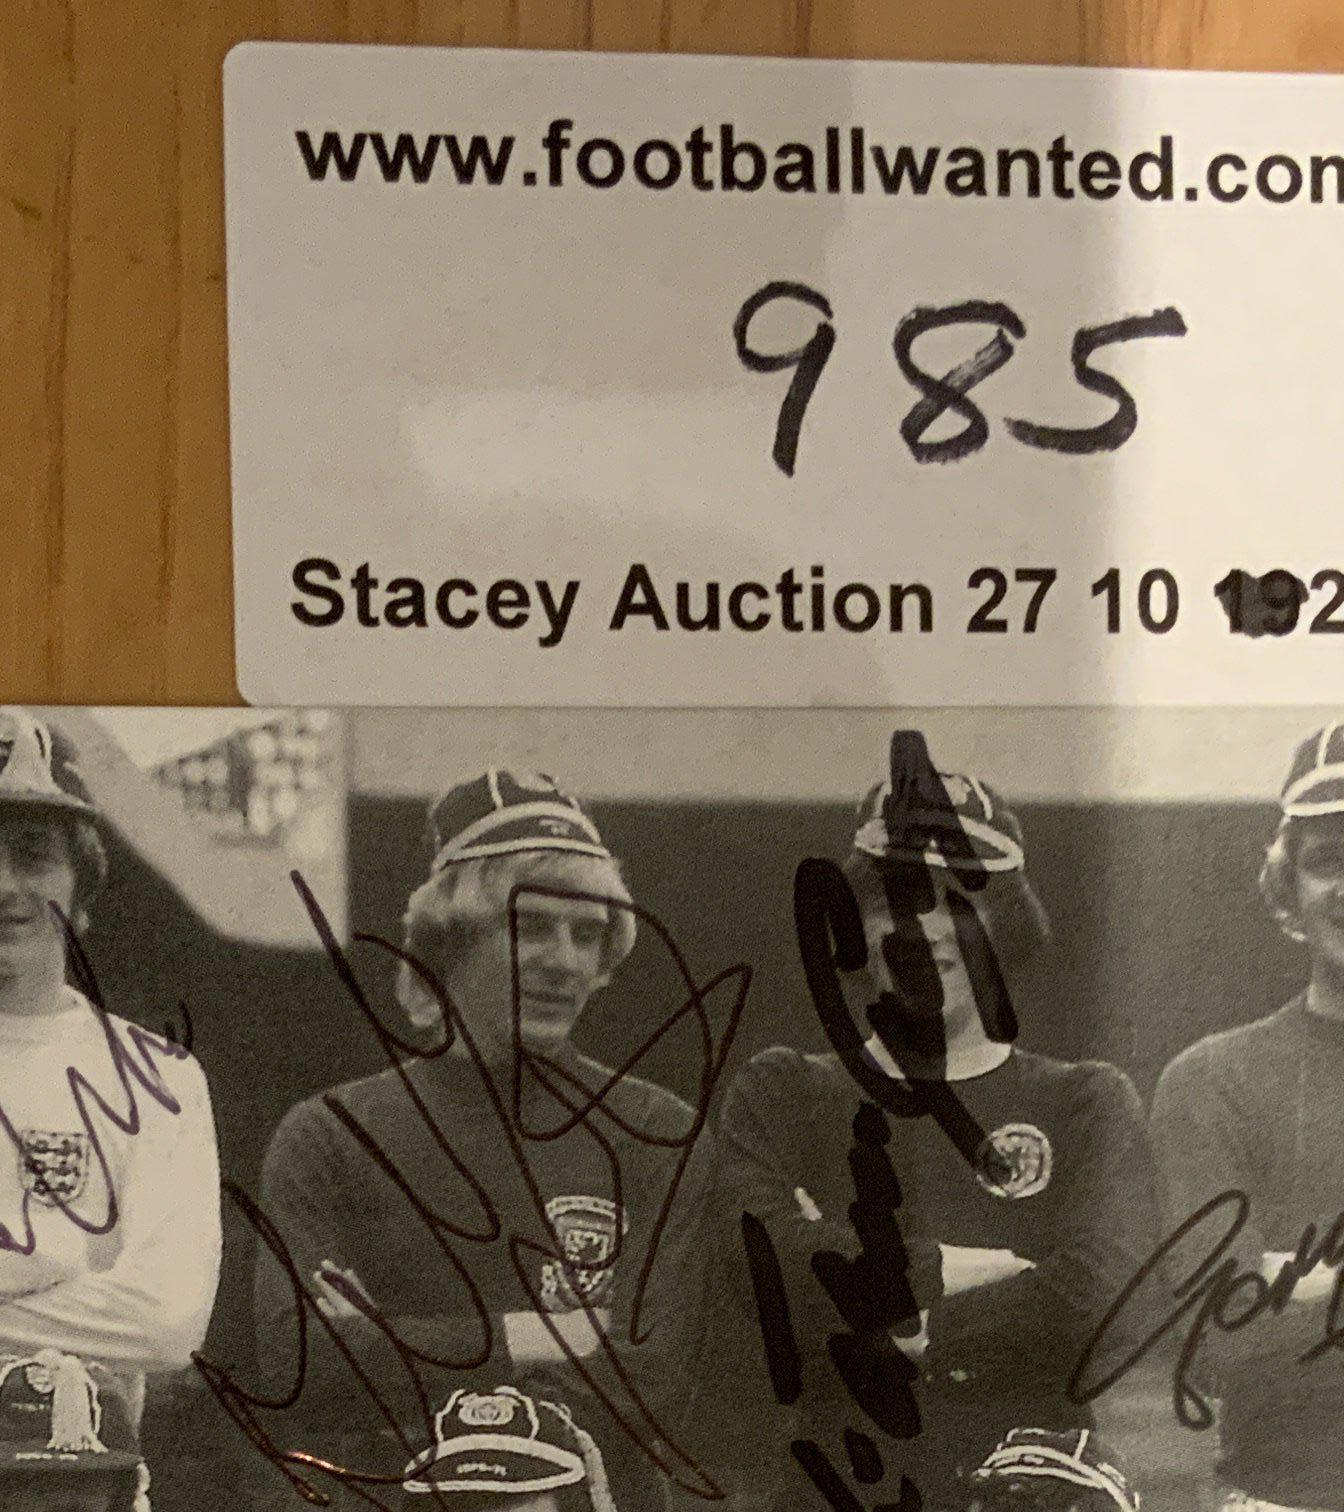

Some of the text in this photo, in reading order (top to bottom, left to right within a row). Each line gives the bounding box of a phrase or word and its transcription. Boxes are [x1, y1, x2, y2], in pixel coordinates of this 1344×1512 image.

[732, 280, 1188, 478] 985
[289, 557, 581, 649] Stacey
[609, 563, 934, 635] Auction
[966, 566, 1058, 635] 27
[1091, 568, 1179, 635] 10
